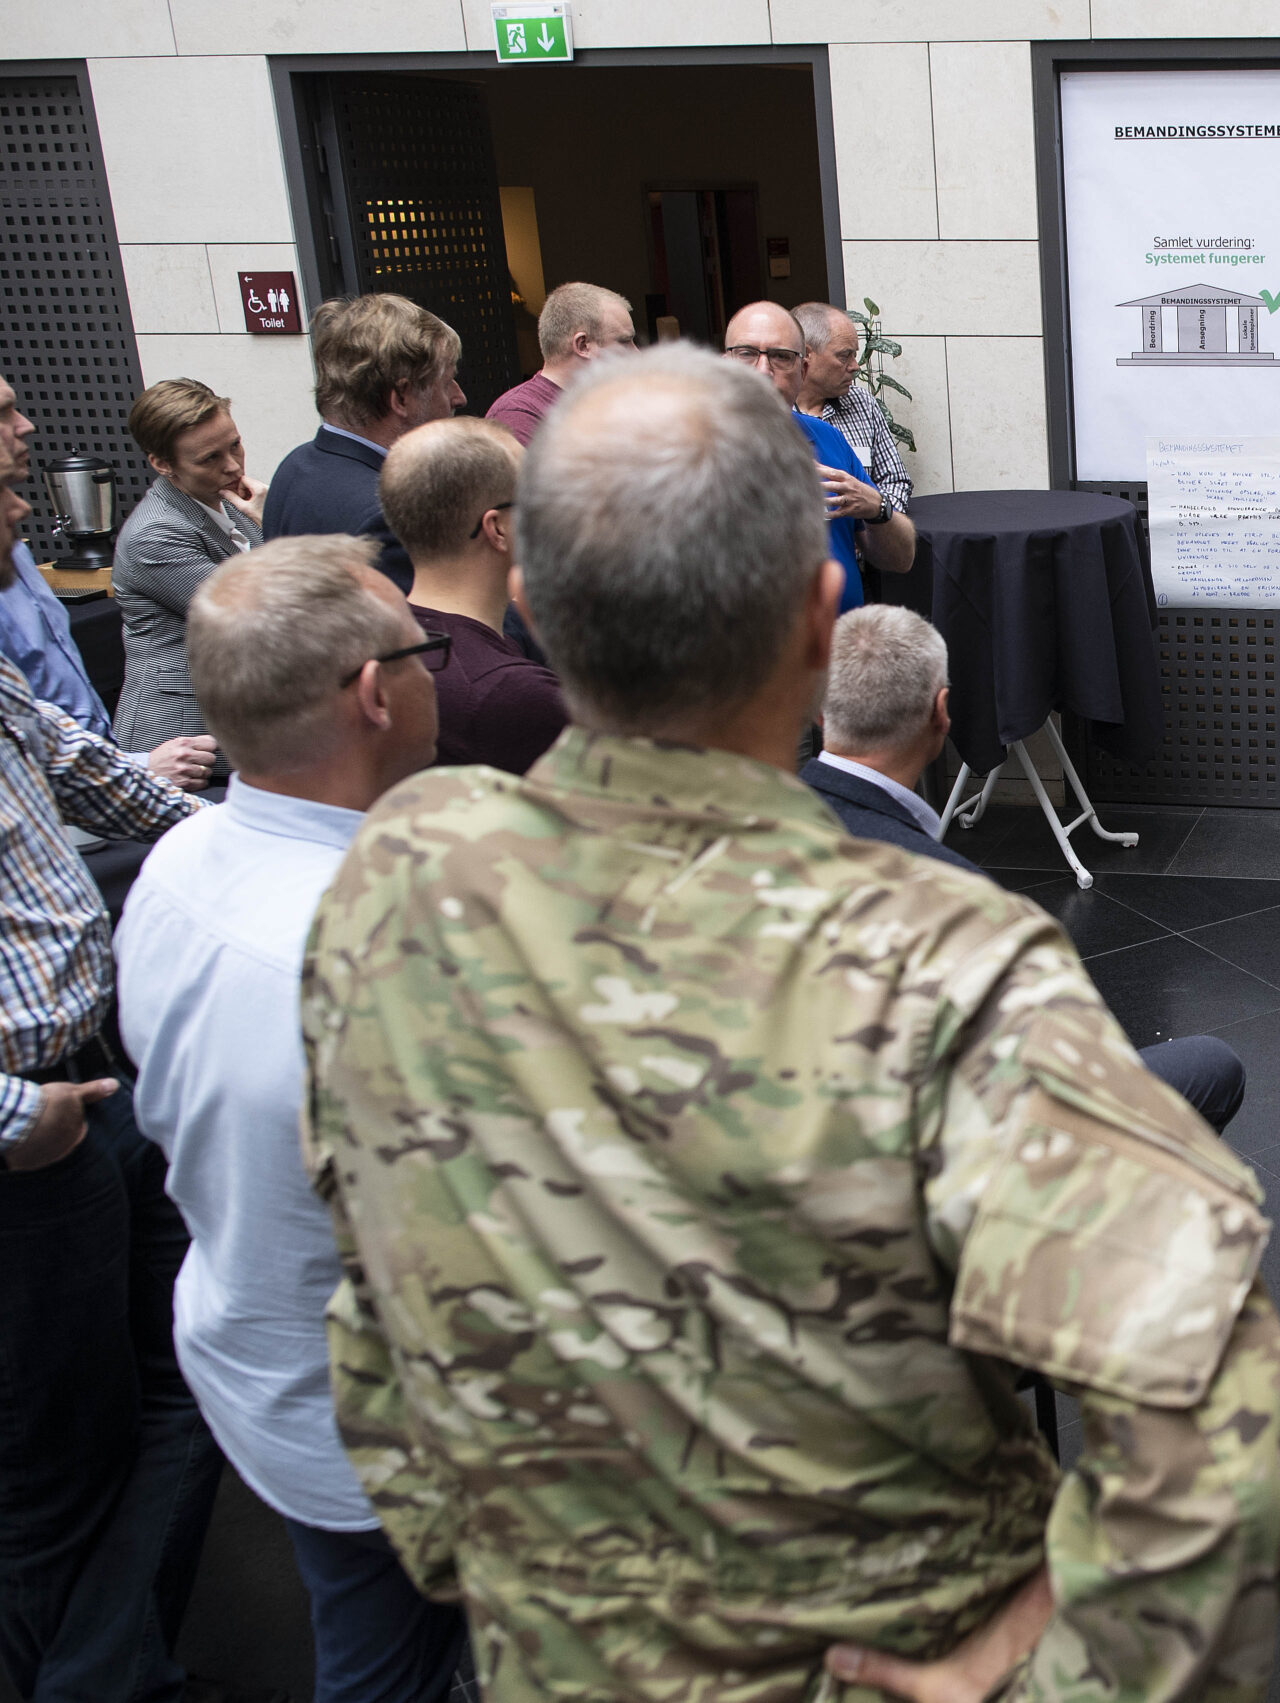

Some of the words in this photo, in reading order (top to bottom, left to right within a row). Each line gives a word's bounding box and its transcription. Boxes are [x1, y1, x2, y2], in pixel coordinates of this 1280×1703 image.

[1153, 236, 1193, 248] Samlet
[1196, 236, 1255, 250] vurdering:
[1145, 253, 1207, 266] Systemet
[1209, 253, 1266, 266] fungerer
[1161, 297, 1241, 305] BEMANDINGSSYSTEMET
[259, 318, 285, 328] Toilet
